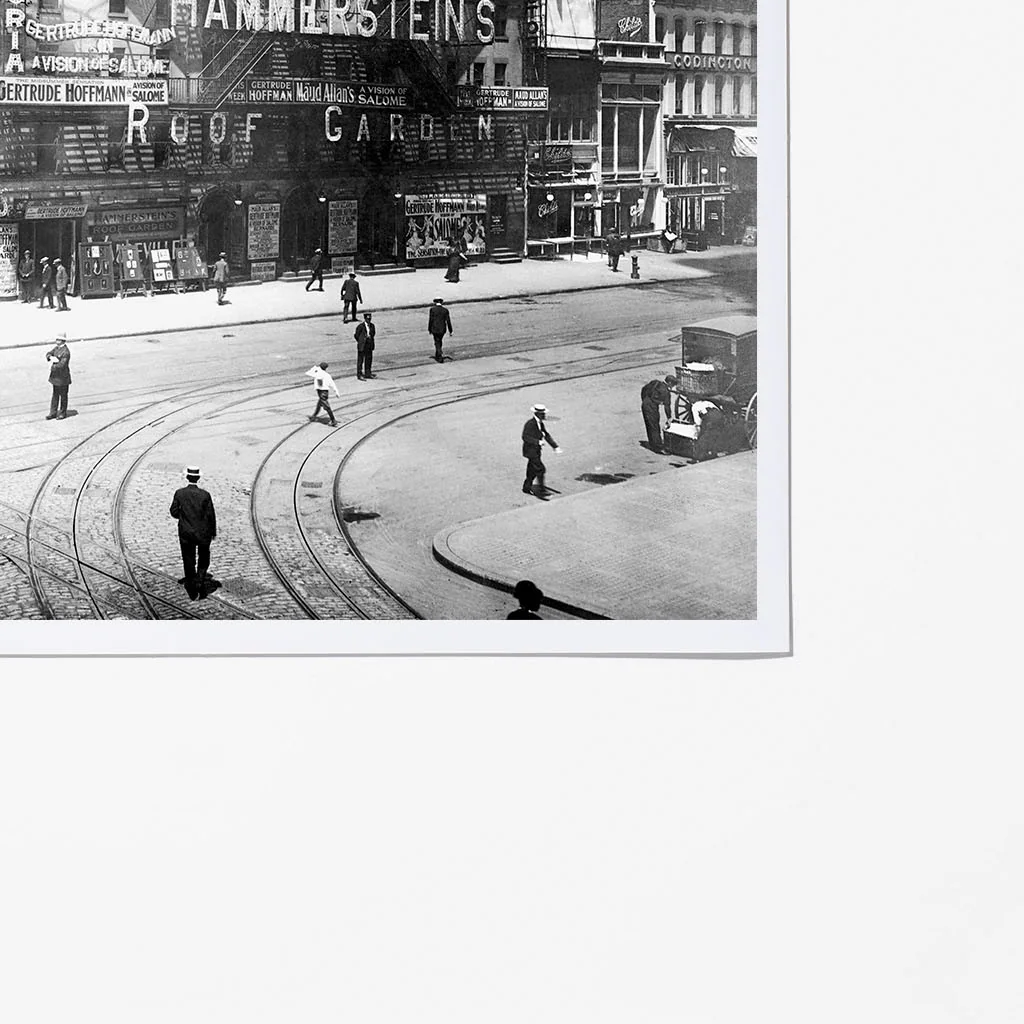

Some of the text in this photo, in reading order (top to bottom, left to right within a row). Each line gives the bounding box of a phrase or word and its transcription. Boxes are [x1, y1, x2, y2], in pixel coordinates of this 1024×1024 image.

[41, 56, 89, 72] VISION
[108, 57, 170, 74] SALOME
[674, 54, 752, 70] CODINGTON
[251, 80, 291, 90] GERTRUDE
[367, 86, 396, 95] VISION
[397, 87, 408, 95] OF
[65, 83, 126, 102] HOFFMANN
[132, 90, 165, 102] SALOME
[249, 90, 293, 102] HOFFMAN
[358, 95, 407, 106] SALOME
[127, 103, 492, 146] ROOF GARDEN
[93, 222, 174, 233] ROOF GARDEN
